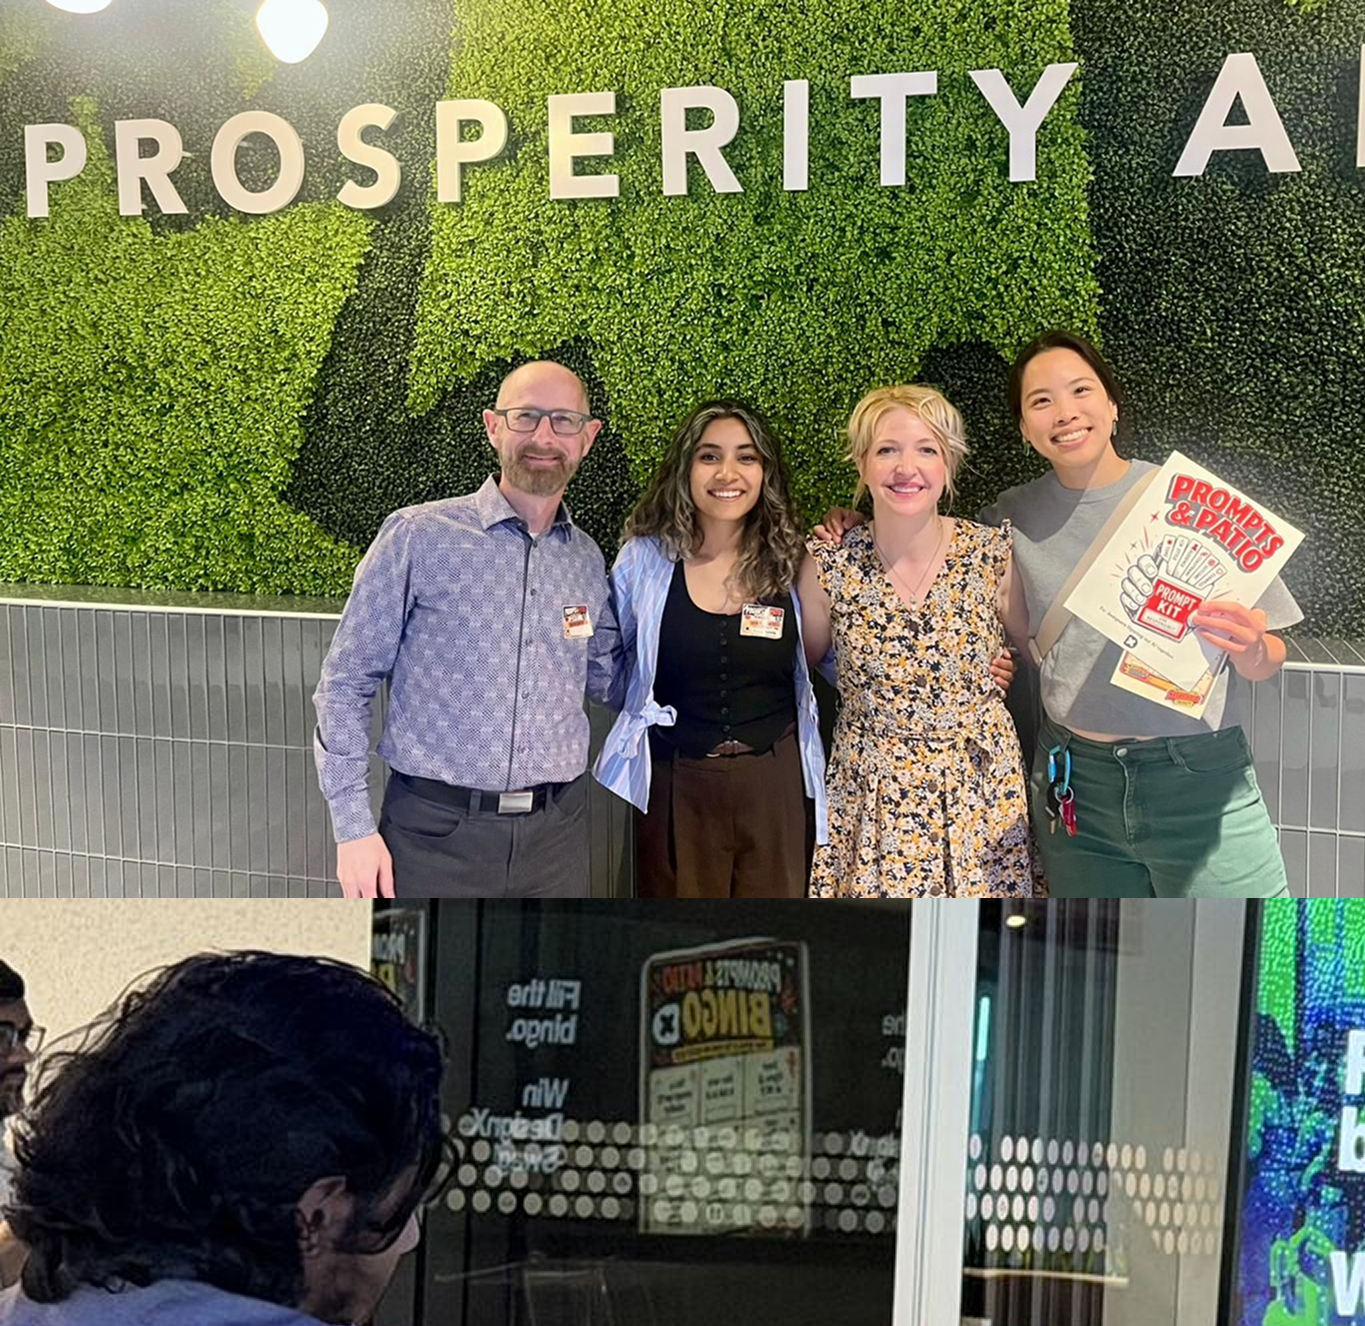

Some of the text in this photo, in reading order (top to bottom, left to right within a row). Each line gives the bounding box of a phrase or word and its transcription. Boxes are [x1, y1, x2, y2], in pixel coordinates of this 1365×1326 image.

[24, 62, 1079, 218] PROSPERITY
[1165, 473, 1285, 560] PROMPTS
[1165, 500, 1196, 527] &
[1193, 506, 1264, 573] PATIO
[1155, 583, 1197, 611] PROMPT
[1157, 600, 1182, 619] KIT
